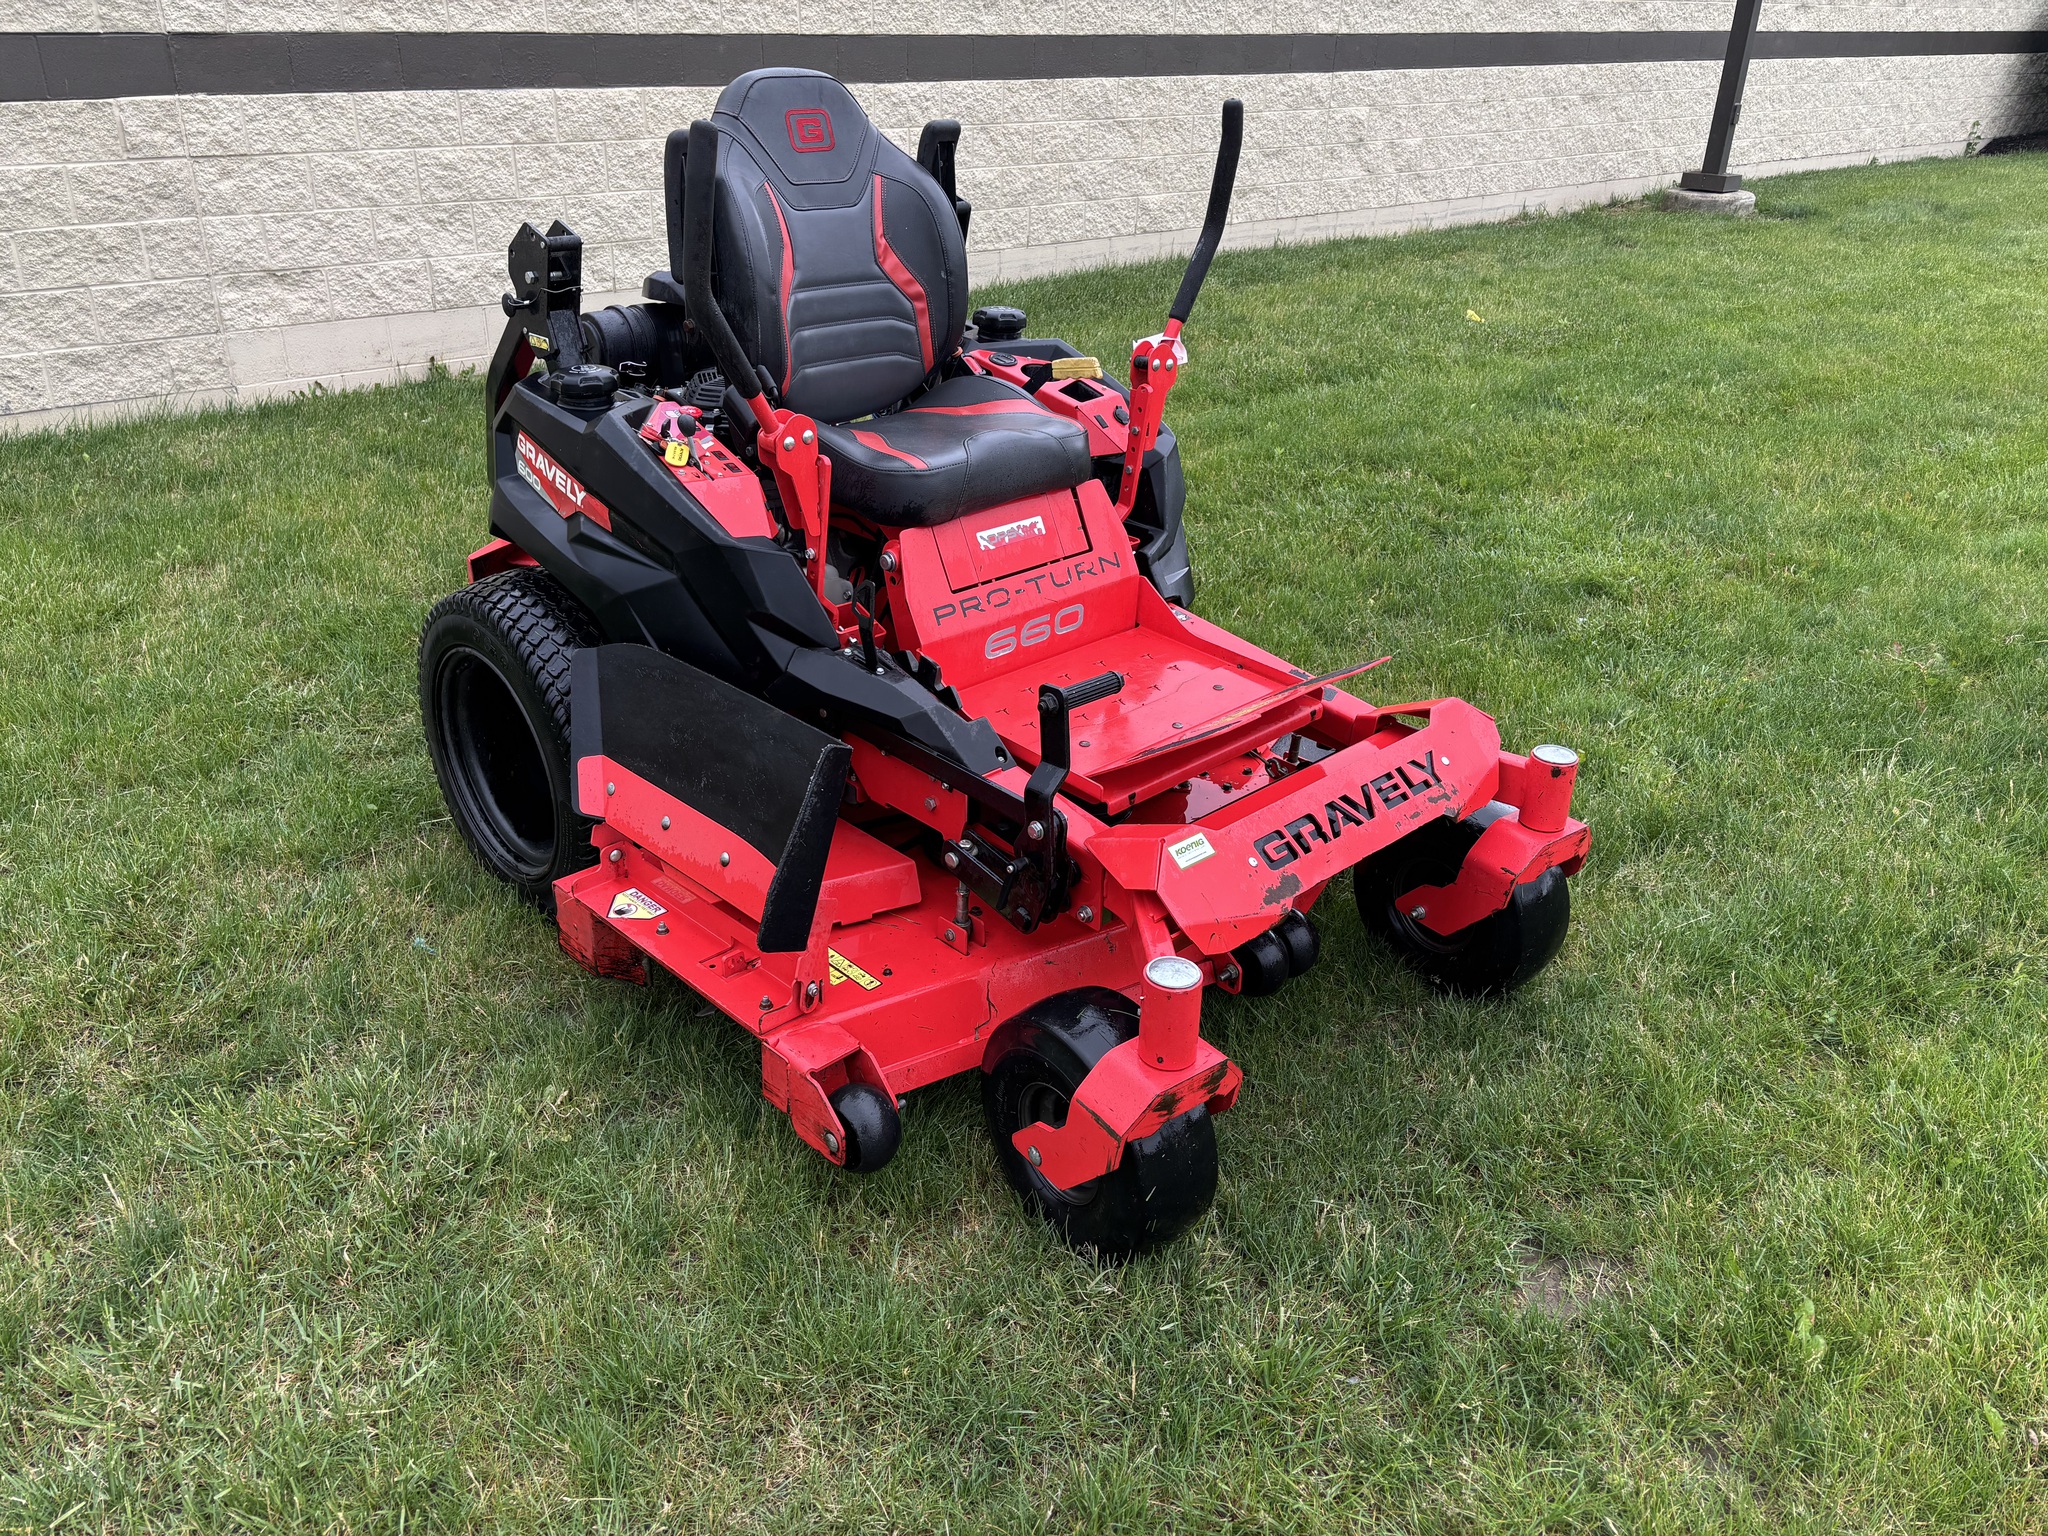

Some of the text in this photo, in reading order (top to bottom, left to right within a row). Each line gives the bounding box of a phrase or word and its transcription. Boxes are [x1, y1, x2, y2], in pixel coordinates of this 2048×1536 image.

[796, 117, 824, 143] G
[517, 433, 586, 507] GRAVELY
[518, 460, 541, 491] 600
[933, 552, 1121, 626] PRO-TURN
[985, 603, 1084, 659] 660
[1253, 750, 1442, 871] GRAVELY
[629, 890, 662, 913] DANGER
